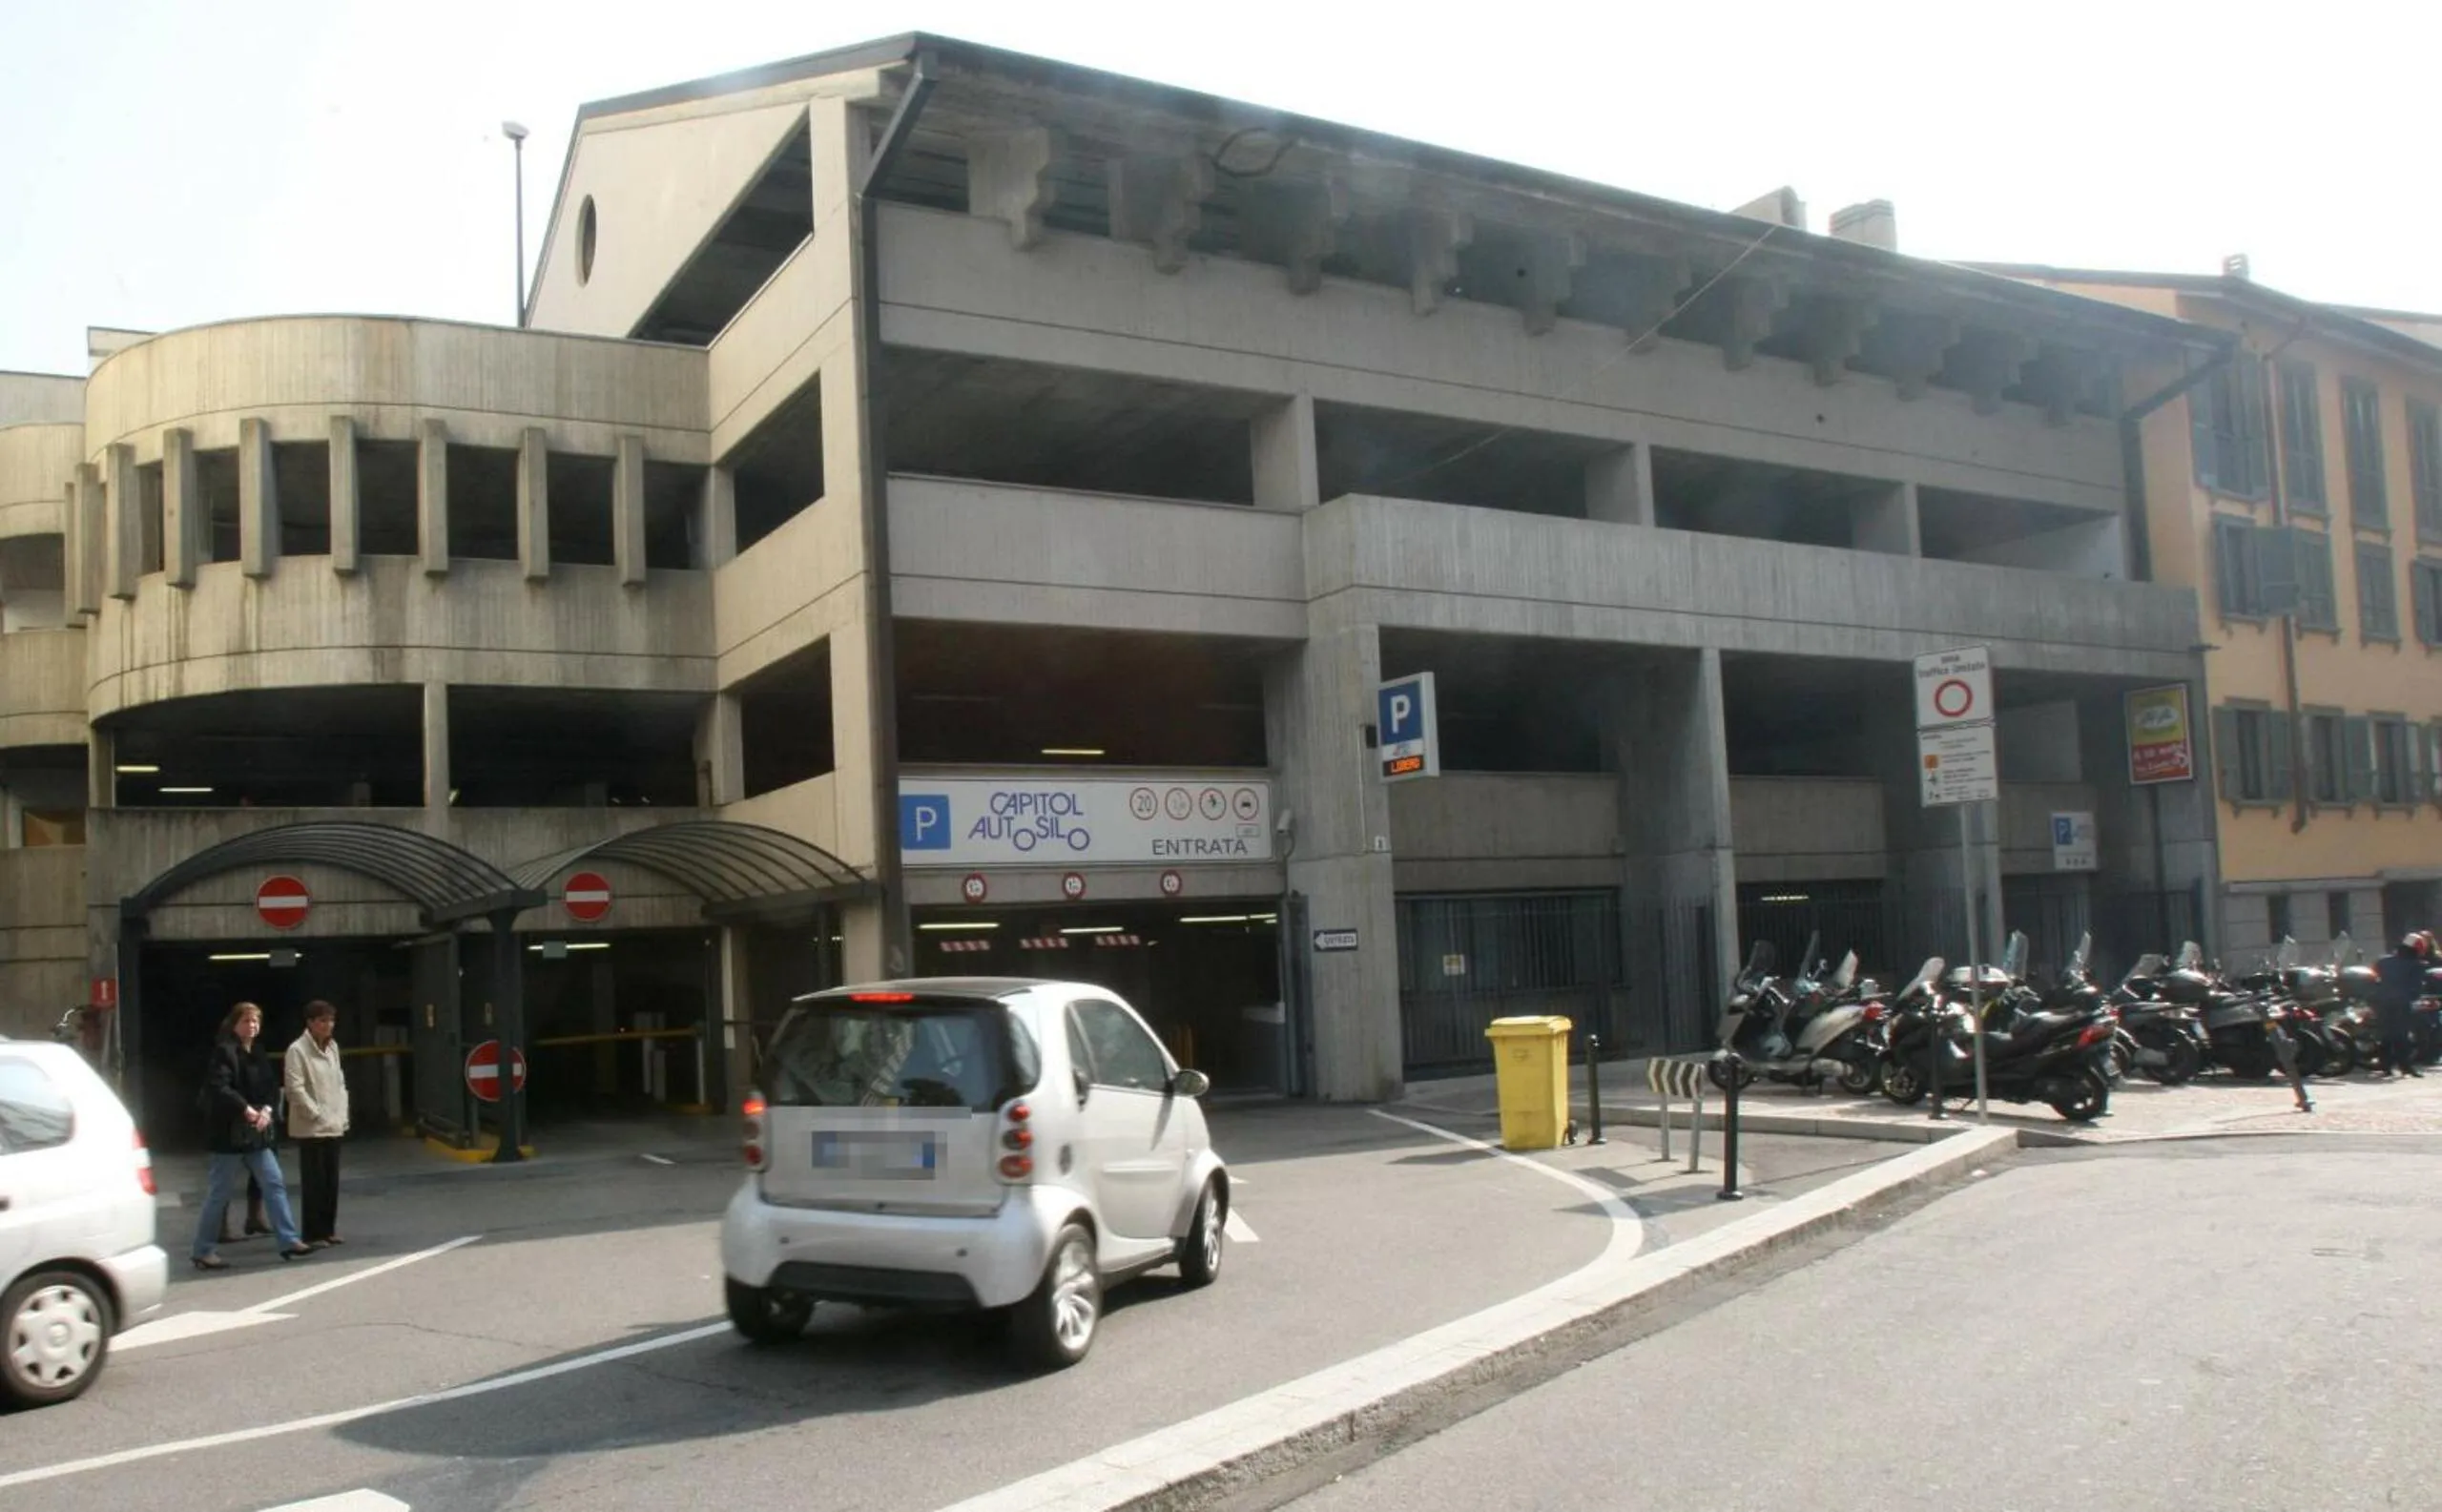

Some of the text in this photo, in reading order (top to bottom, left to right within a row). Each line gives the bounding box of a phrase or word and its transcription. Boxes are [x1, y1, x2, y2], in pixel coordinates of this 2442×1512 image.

[1391, 694, 1411, 734] P
[990, 792, 1084, 816] CAPITOL
[916, 807, 937, 840] P
[968, 817, 1091, 852] AUTOSILO
[1152, 839, 1248, 856] ENTRATA
